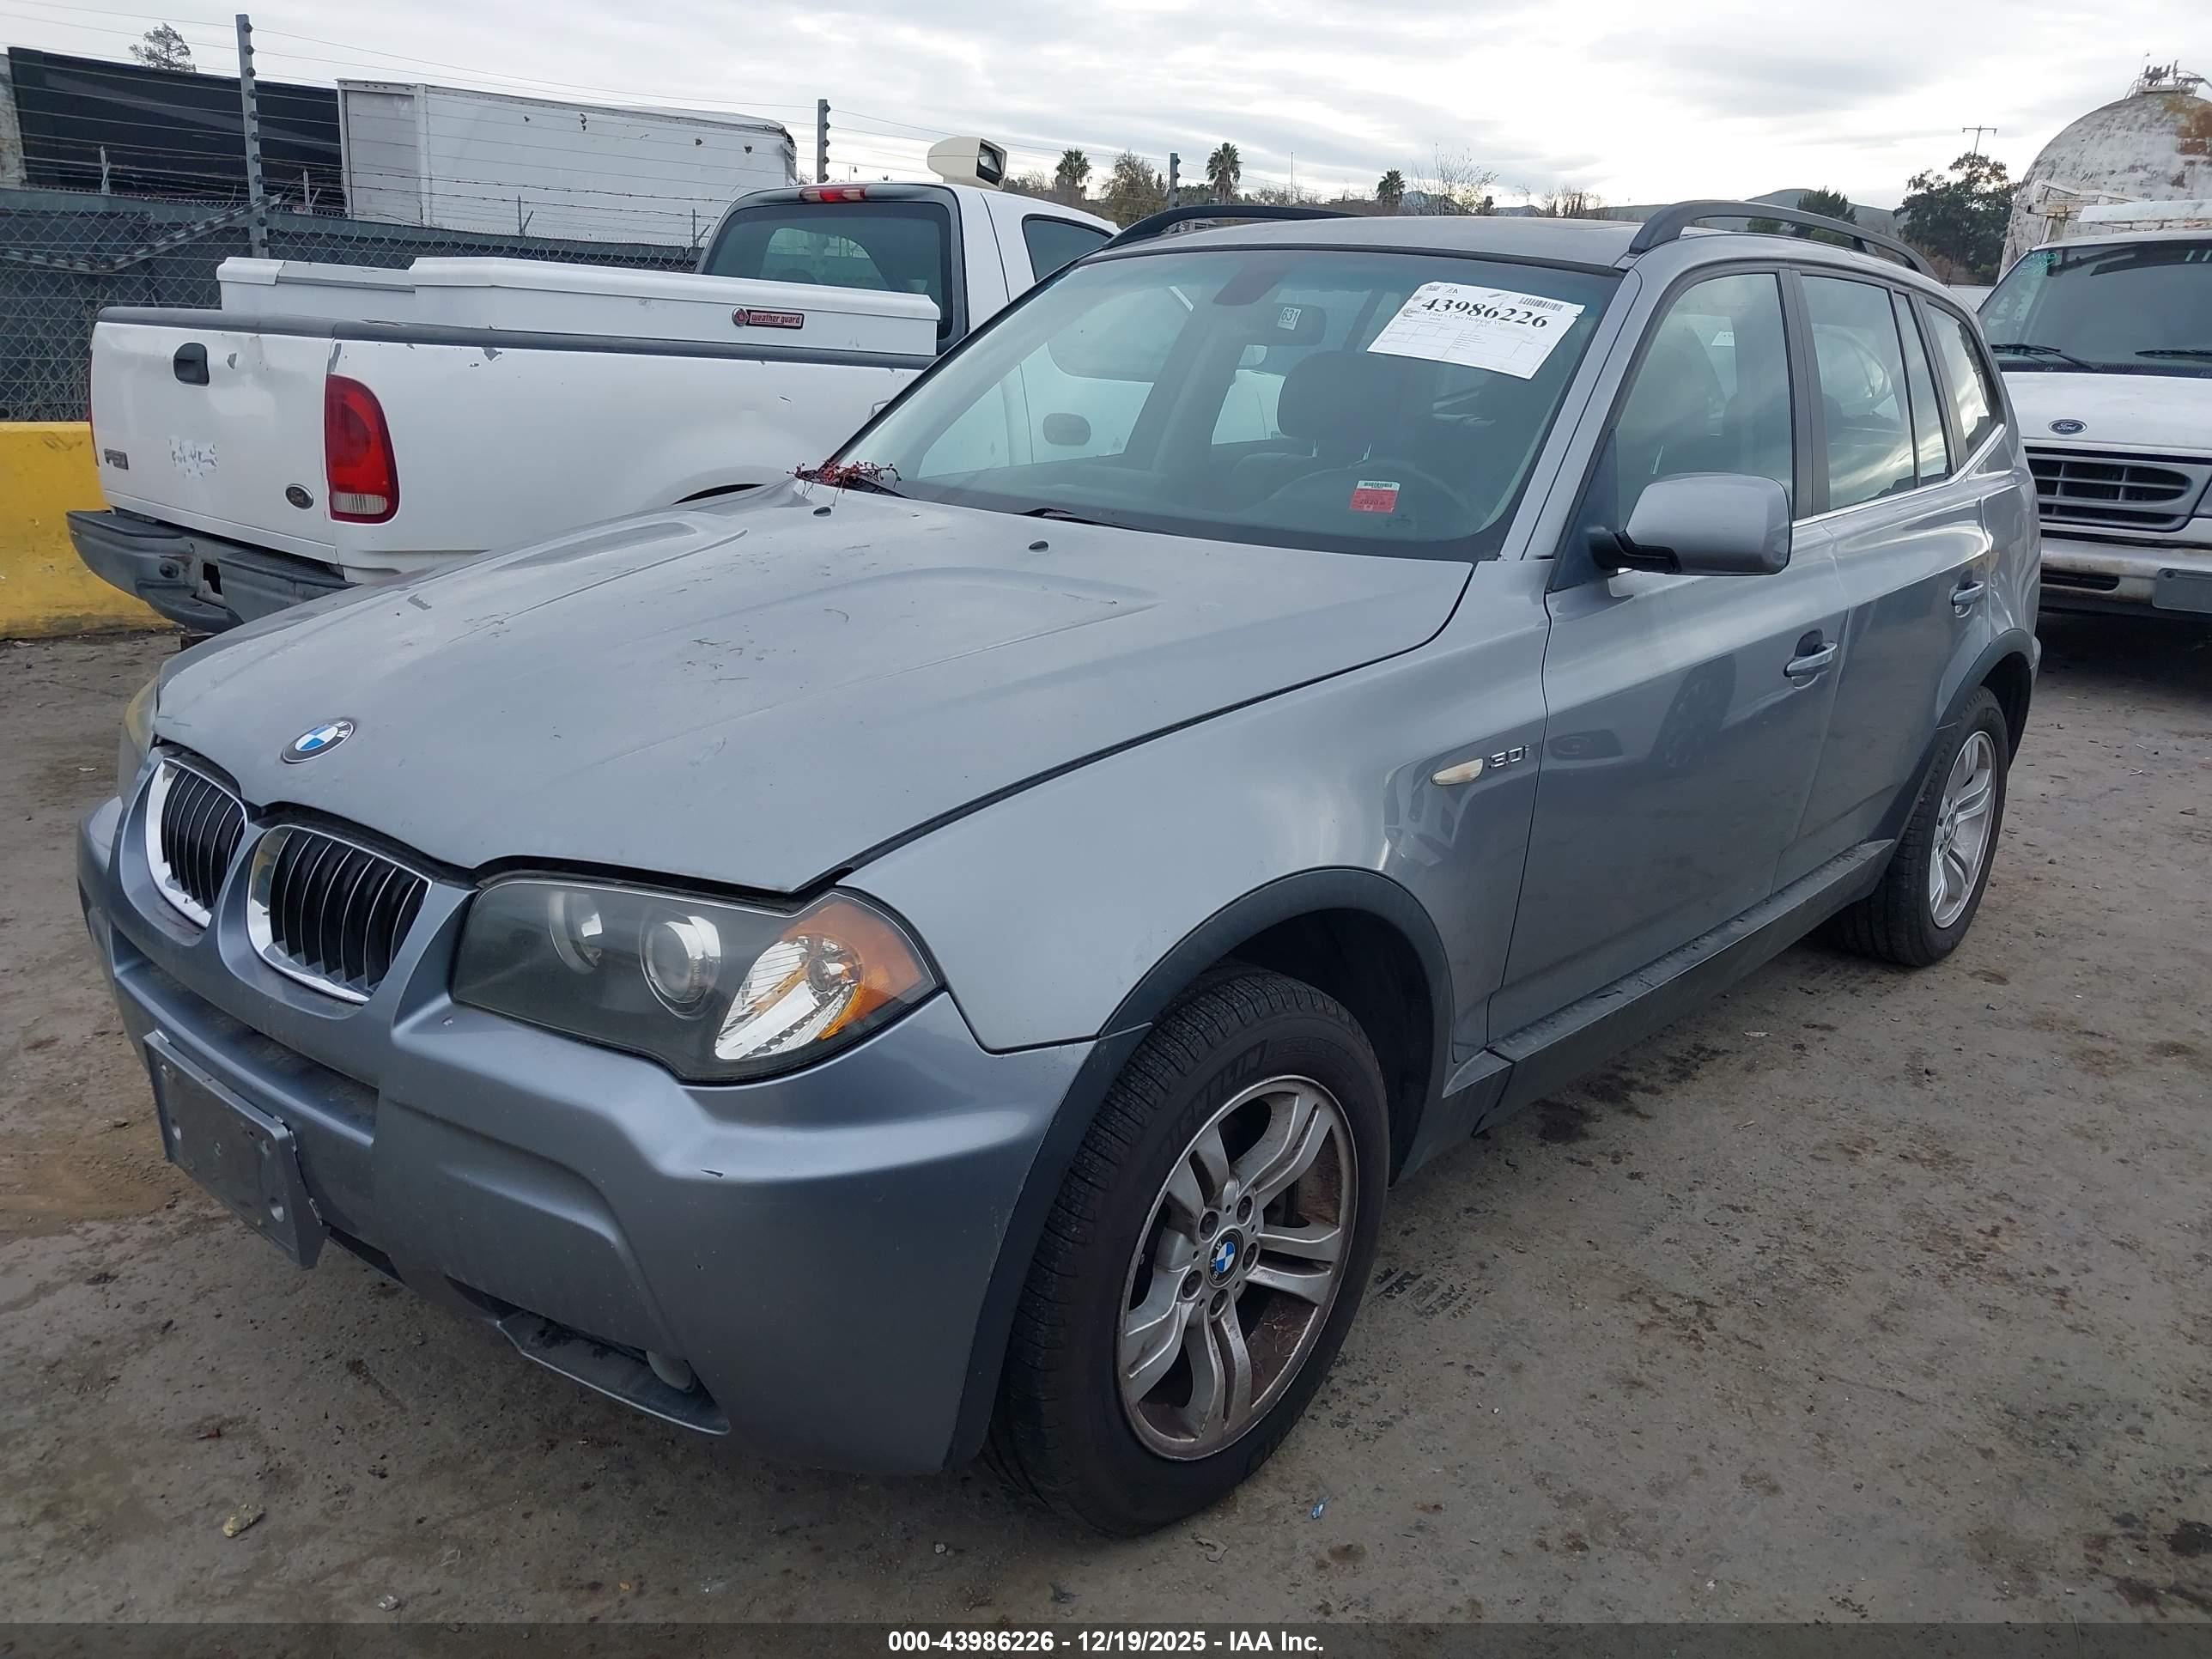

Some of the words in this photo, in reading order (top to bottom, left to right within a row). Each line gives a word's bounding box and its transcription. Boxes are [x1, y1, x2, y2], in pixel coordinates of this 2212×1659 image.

[751, 313, 780, 322] weather
[781, 315, 800, 324] guard
[1421, 298, 1552, 327] 43986226
[2057, 422, 2078, 431] Ford
[1211, 1239, 1224, 1279] BMW
